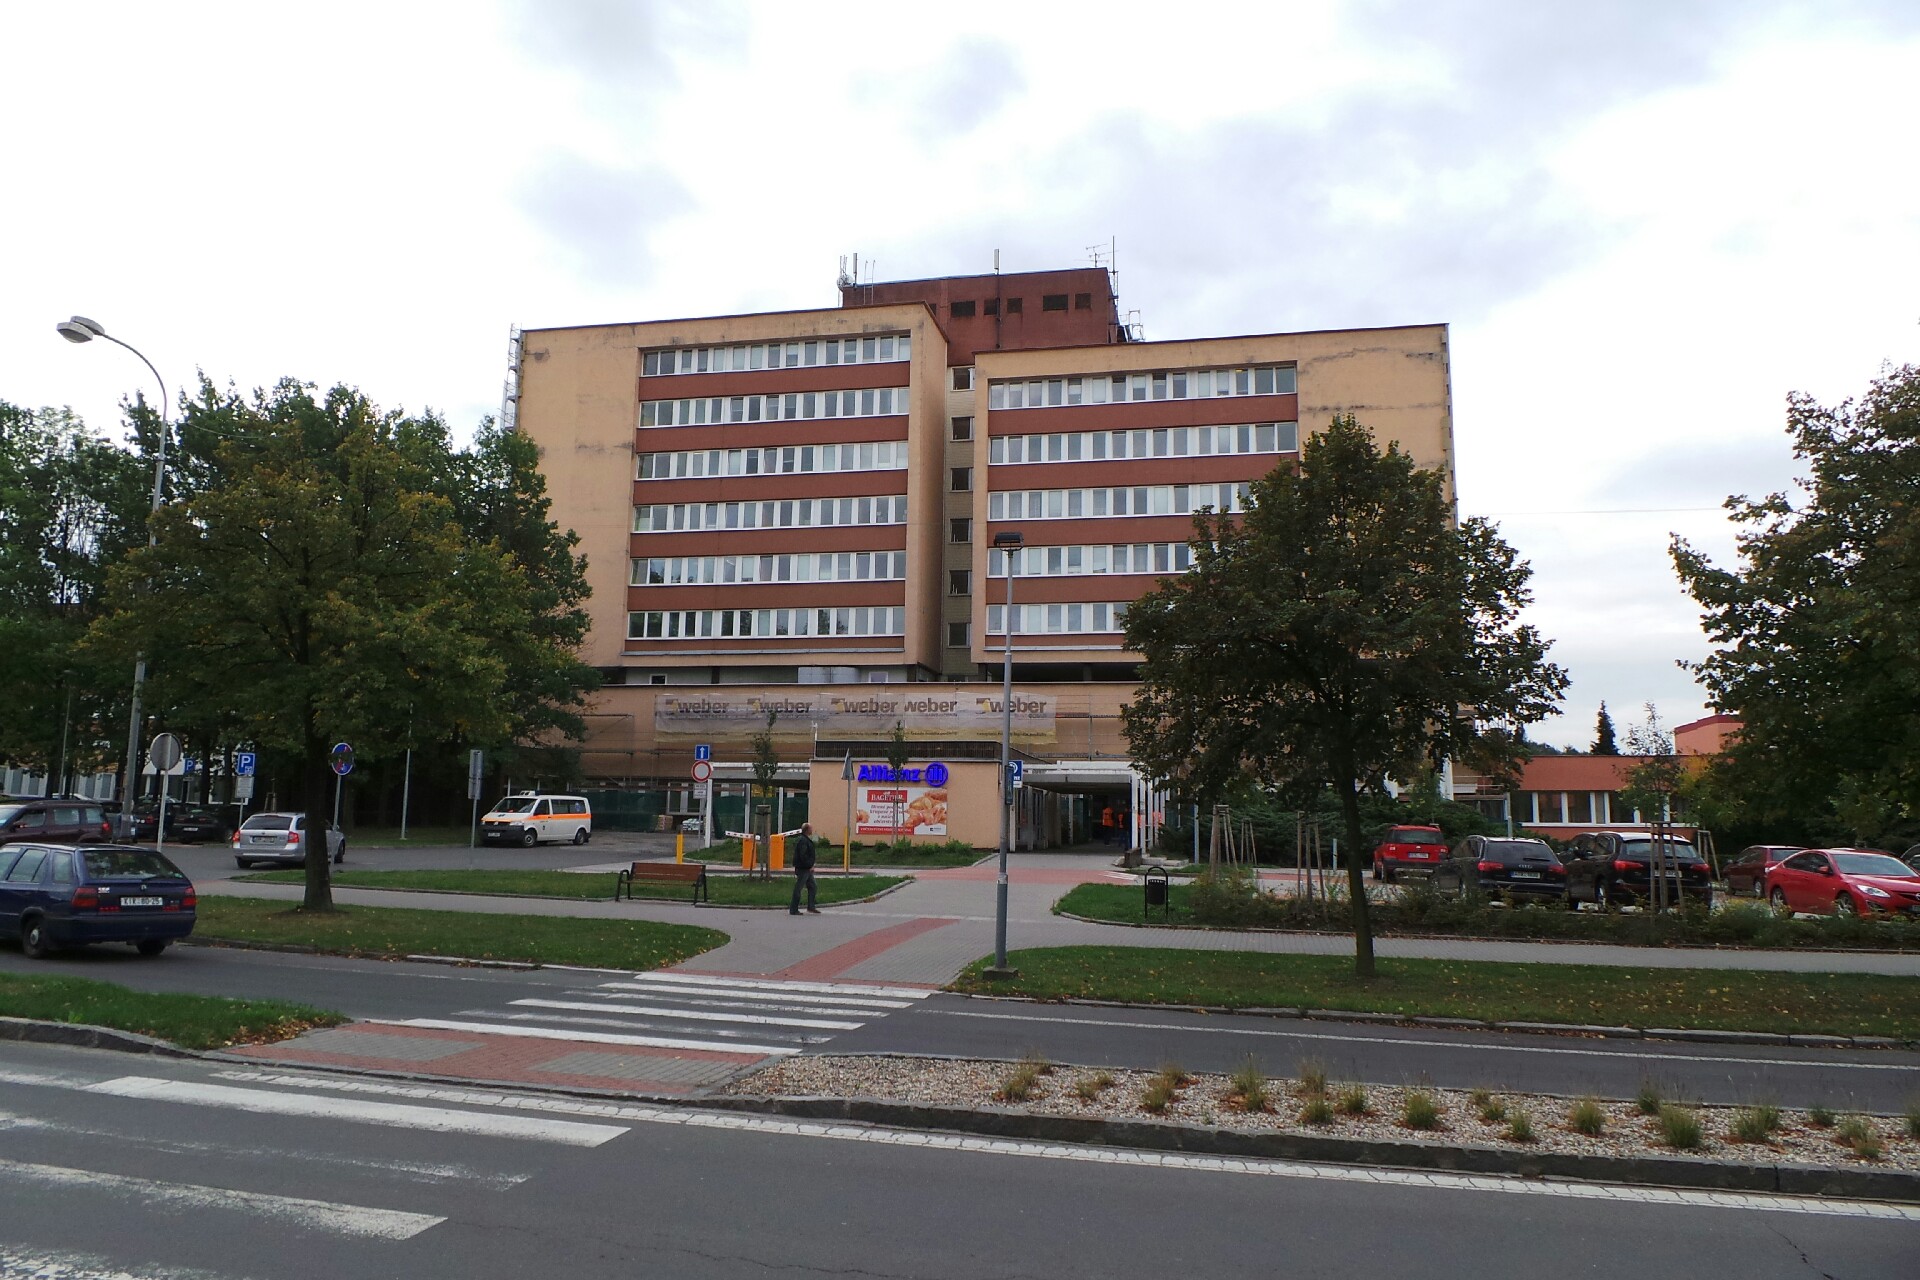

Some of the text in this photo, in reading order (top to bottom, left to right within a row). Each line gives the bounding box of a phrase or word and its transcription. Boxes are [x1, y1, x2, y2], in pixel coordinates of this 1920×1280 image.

[678, 698, 730, 714] weber
[759, 698, 813, 714] weber
[843, 697, 899, 713] weber
[904, 697, 958, 713] weber
[989, 698, 1047, 714] weber
[186, 760, 193, 771] P
[241, 755, 251, 768] P
